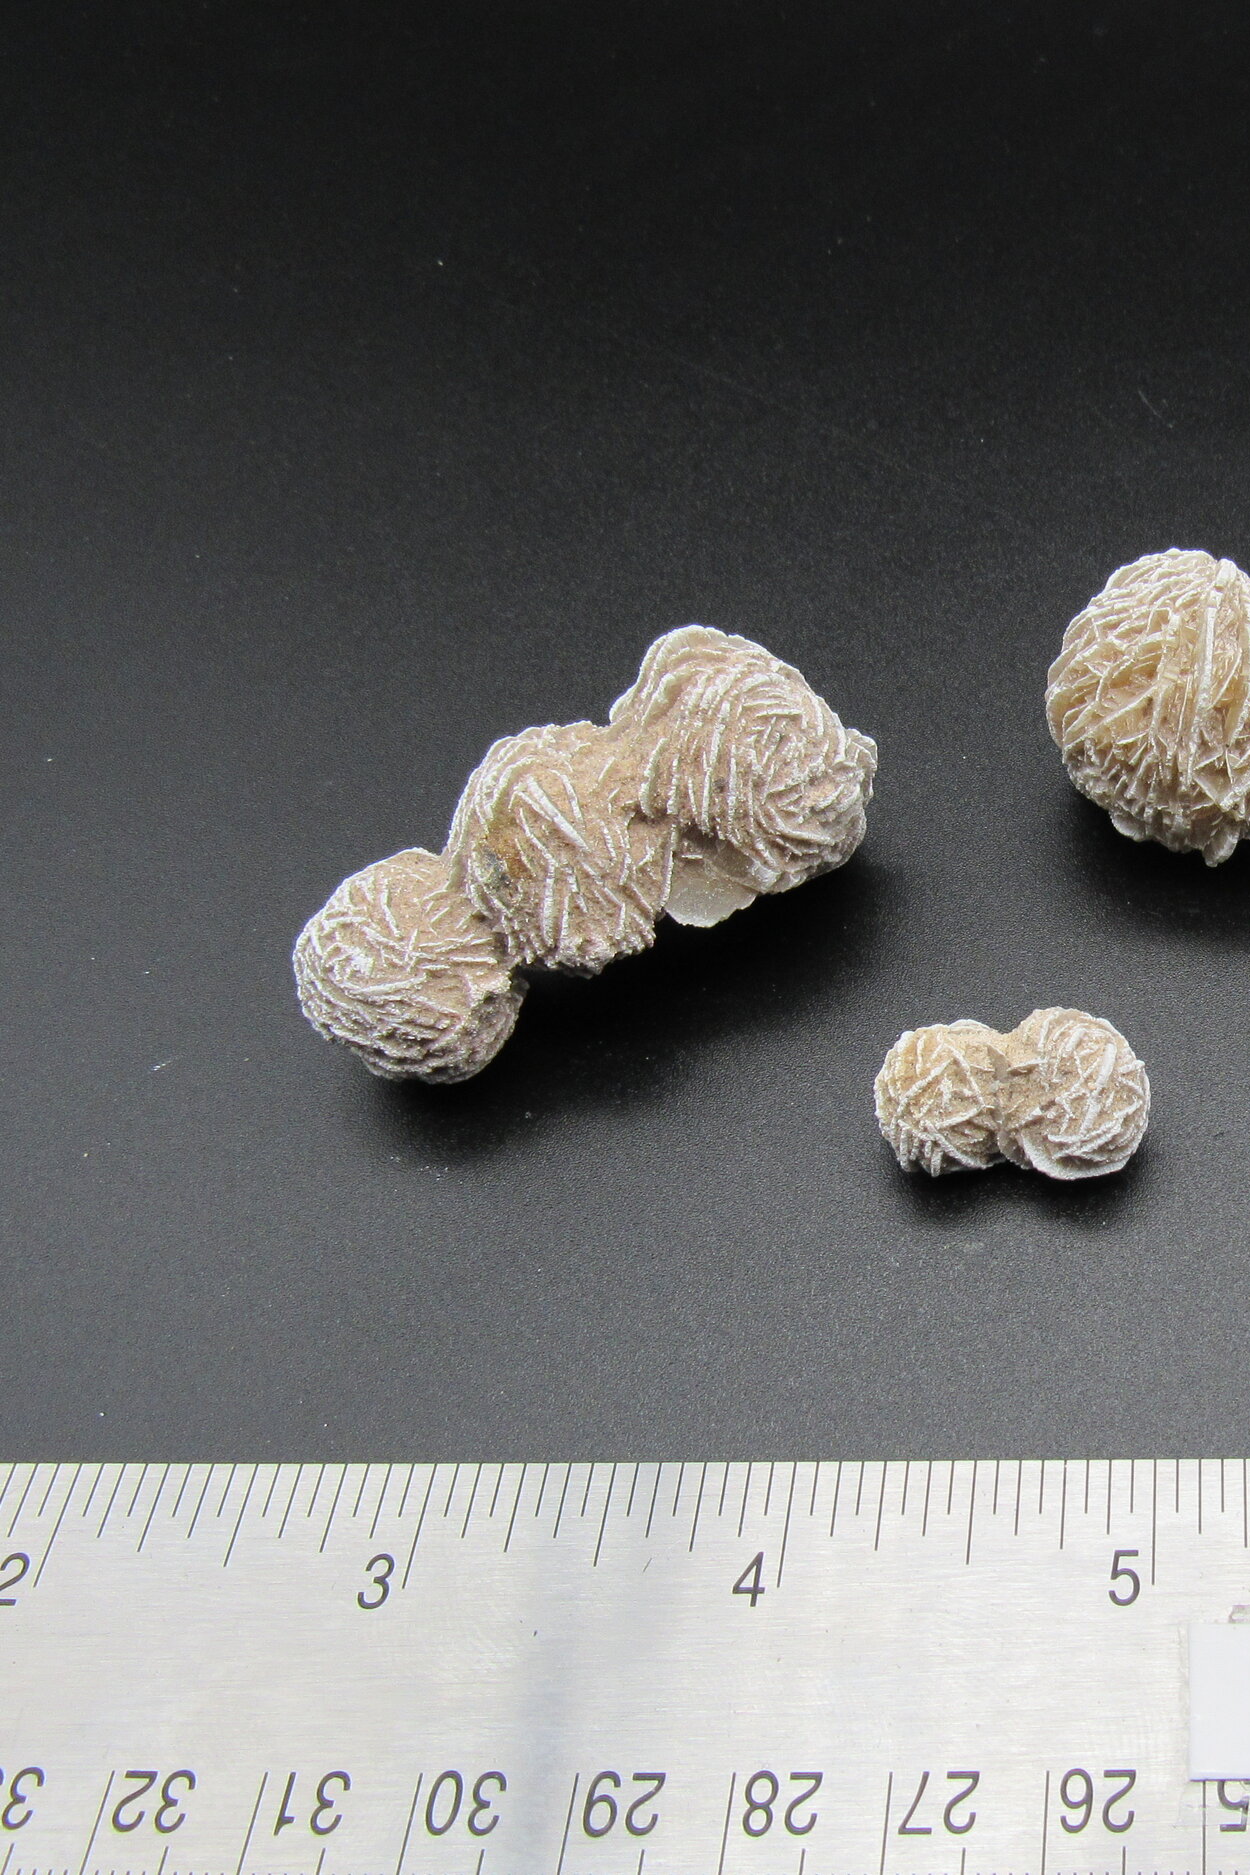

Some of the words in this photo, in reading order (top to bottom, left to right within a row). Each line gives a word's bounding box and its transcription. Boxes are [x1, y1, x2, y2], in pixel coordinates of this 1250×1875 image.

[357, 1553, 395, 1610] 3
[731, 1551, 766, 1608] 4
[1108, 1549, 1141, 1607] 5
[0, 1766, 45, 1830] 3
[112, 1769, 197, 1834] 32
[273, 1769, 352, 1837] 31
[425, 1769, 507, 1837] 30
[582, 1770, 667, 1839] 29
[742, 1769, 824, 1838] 28
[897, 1770, 981, 1836] 27
[1059, 1767, 1137, 1834] 26
